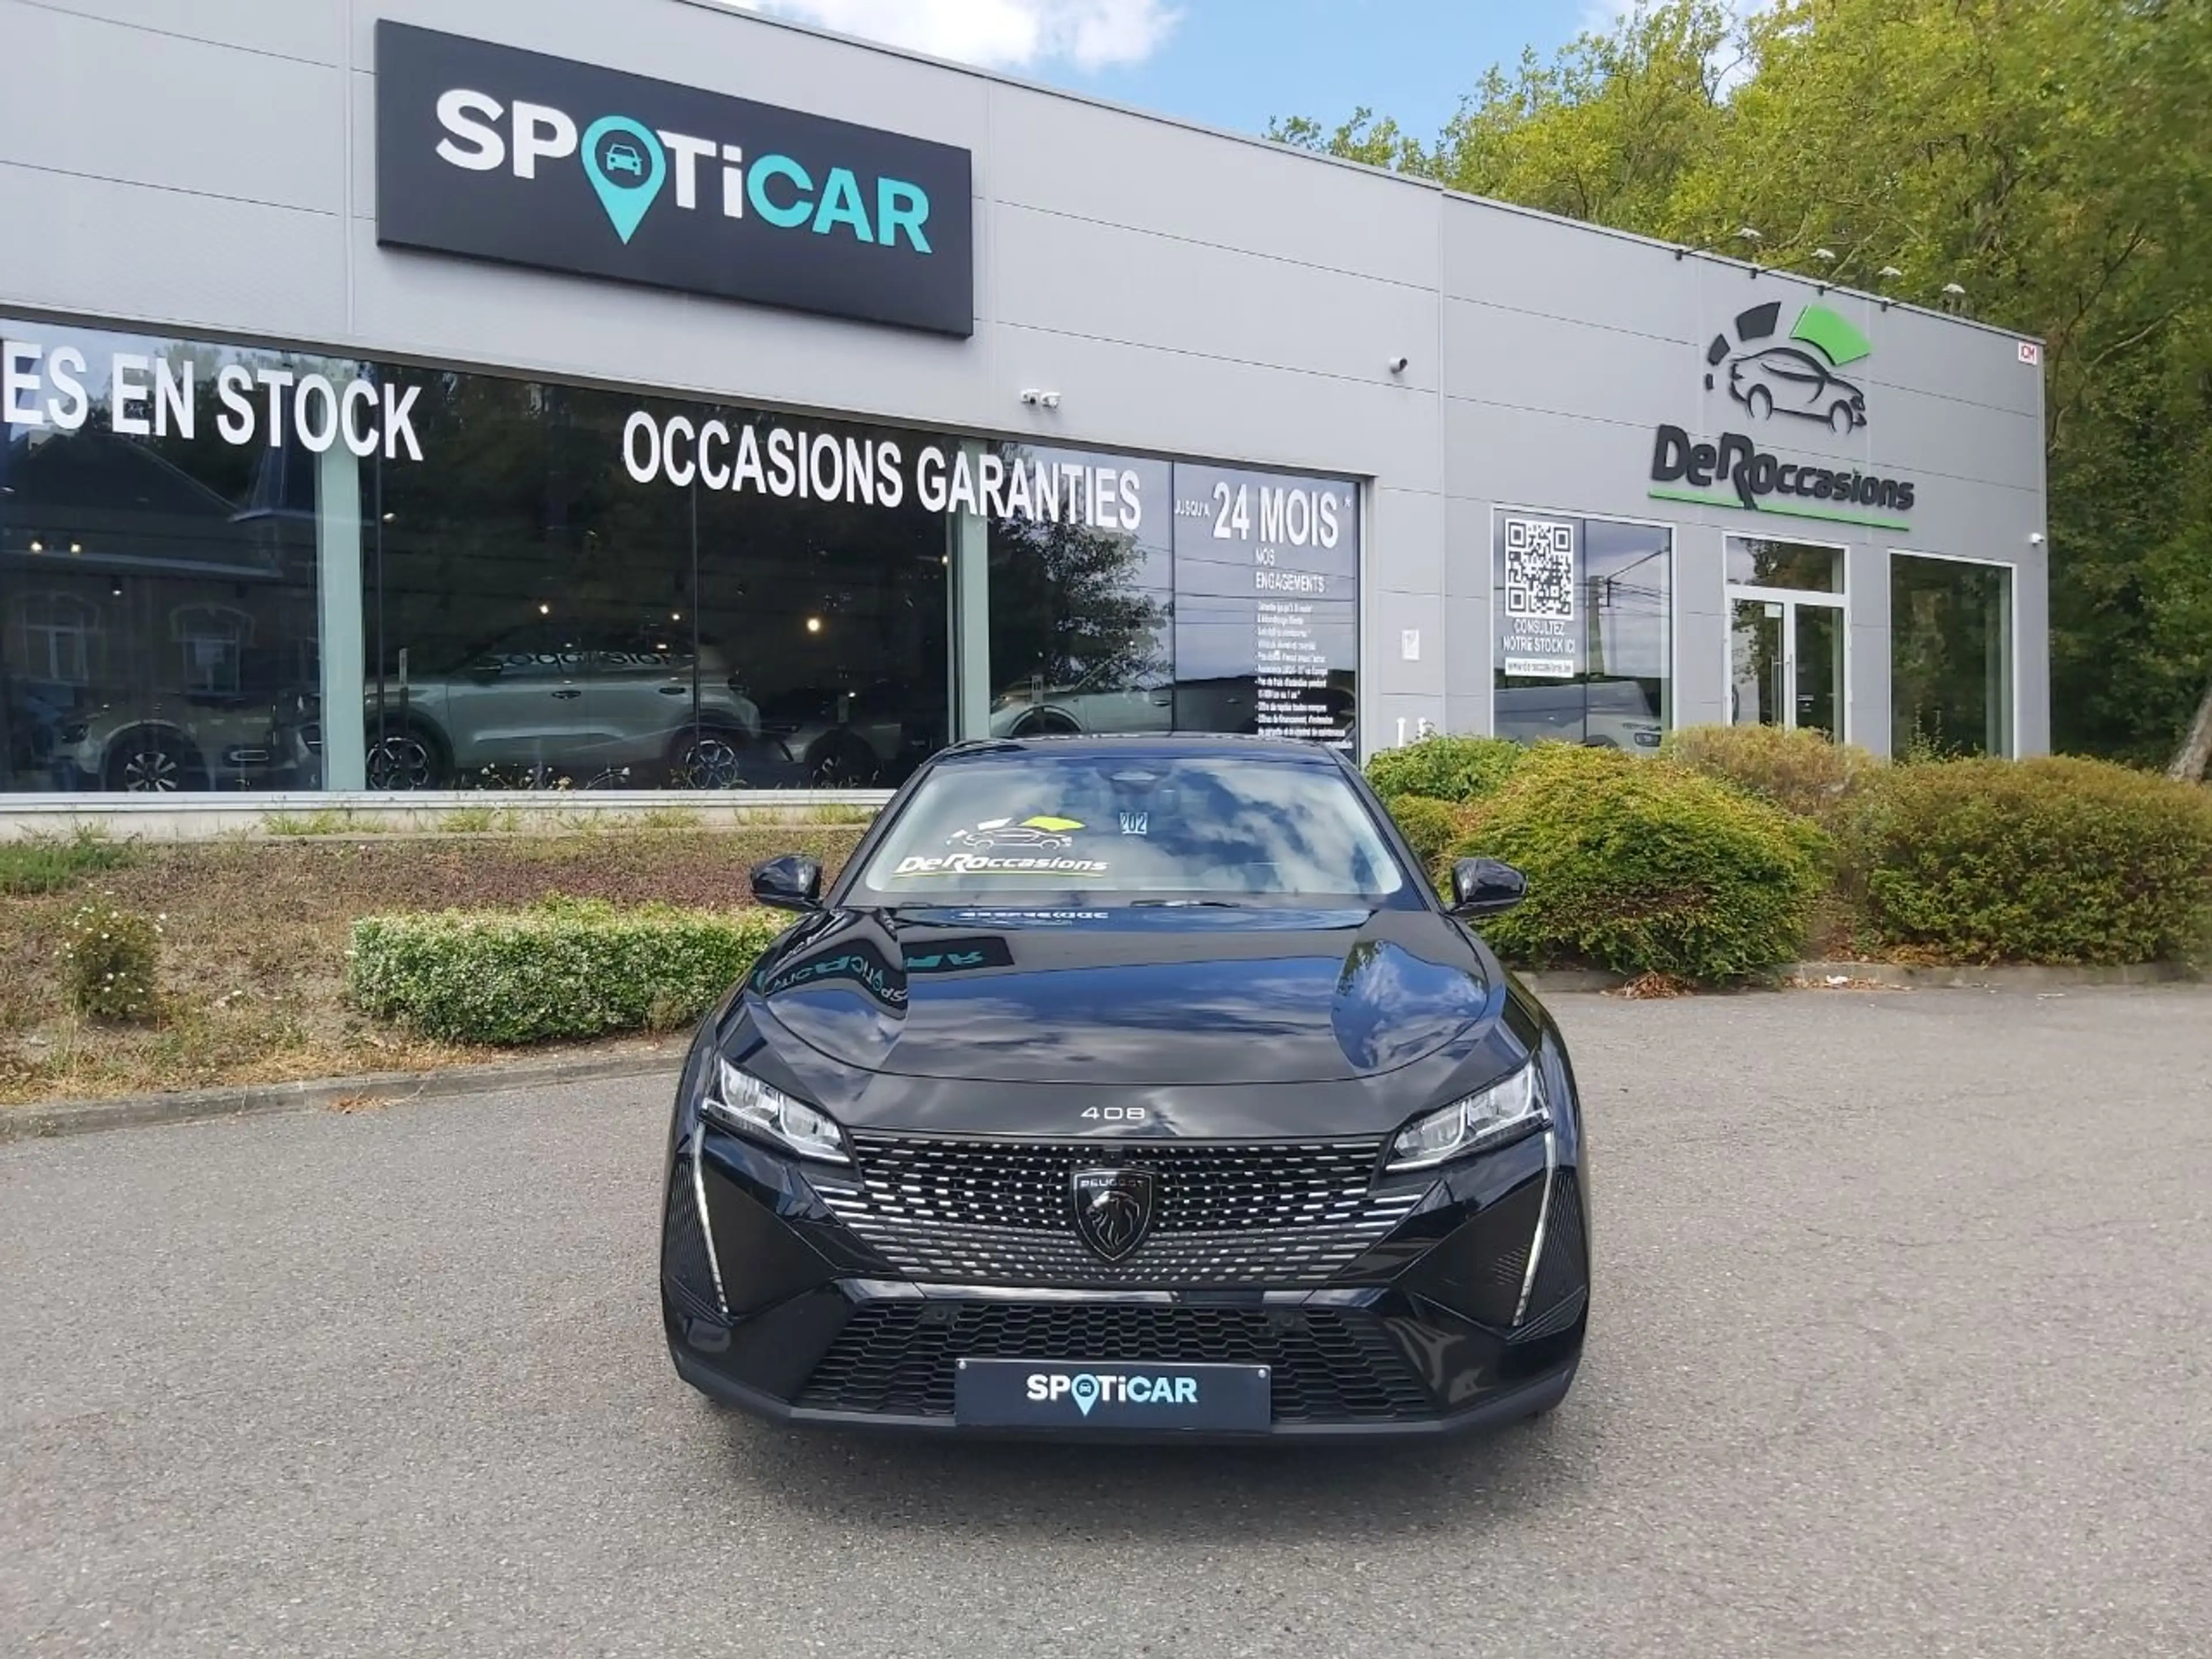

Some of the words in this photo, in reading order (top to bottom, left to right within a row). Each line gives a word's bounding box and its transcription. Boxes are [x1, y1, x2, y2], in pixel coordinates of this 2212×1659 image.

[3, 340, 88, 430] ES
[112, 352, 195, 439] EN
[217, 364, 423, 461] STOCK
[623, 411, 903, 507] OCCASIONS
[917, 446, 1142, 529] GARANTIES
[1212, 482, 1250, 540] 24
[1256, 548, 1275, 566] NOS
[1514, 618, 1566, 636] CONSULTEZ
[1502, 635, 1532, 652] NOTRE
[1534, 637, 1563, 653] STOCK
[1080, 1106, 1146, 1120] 408
